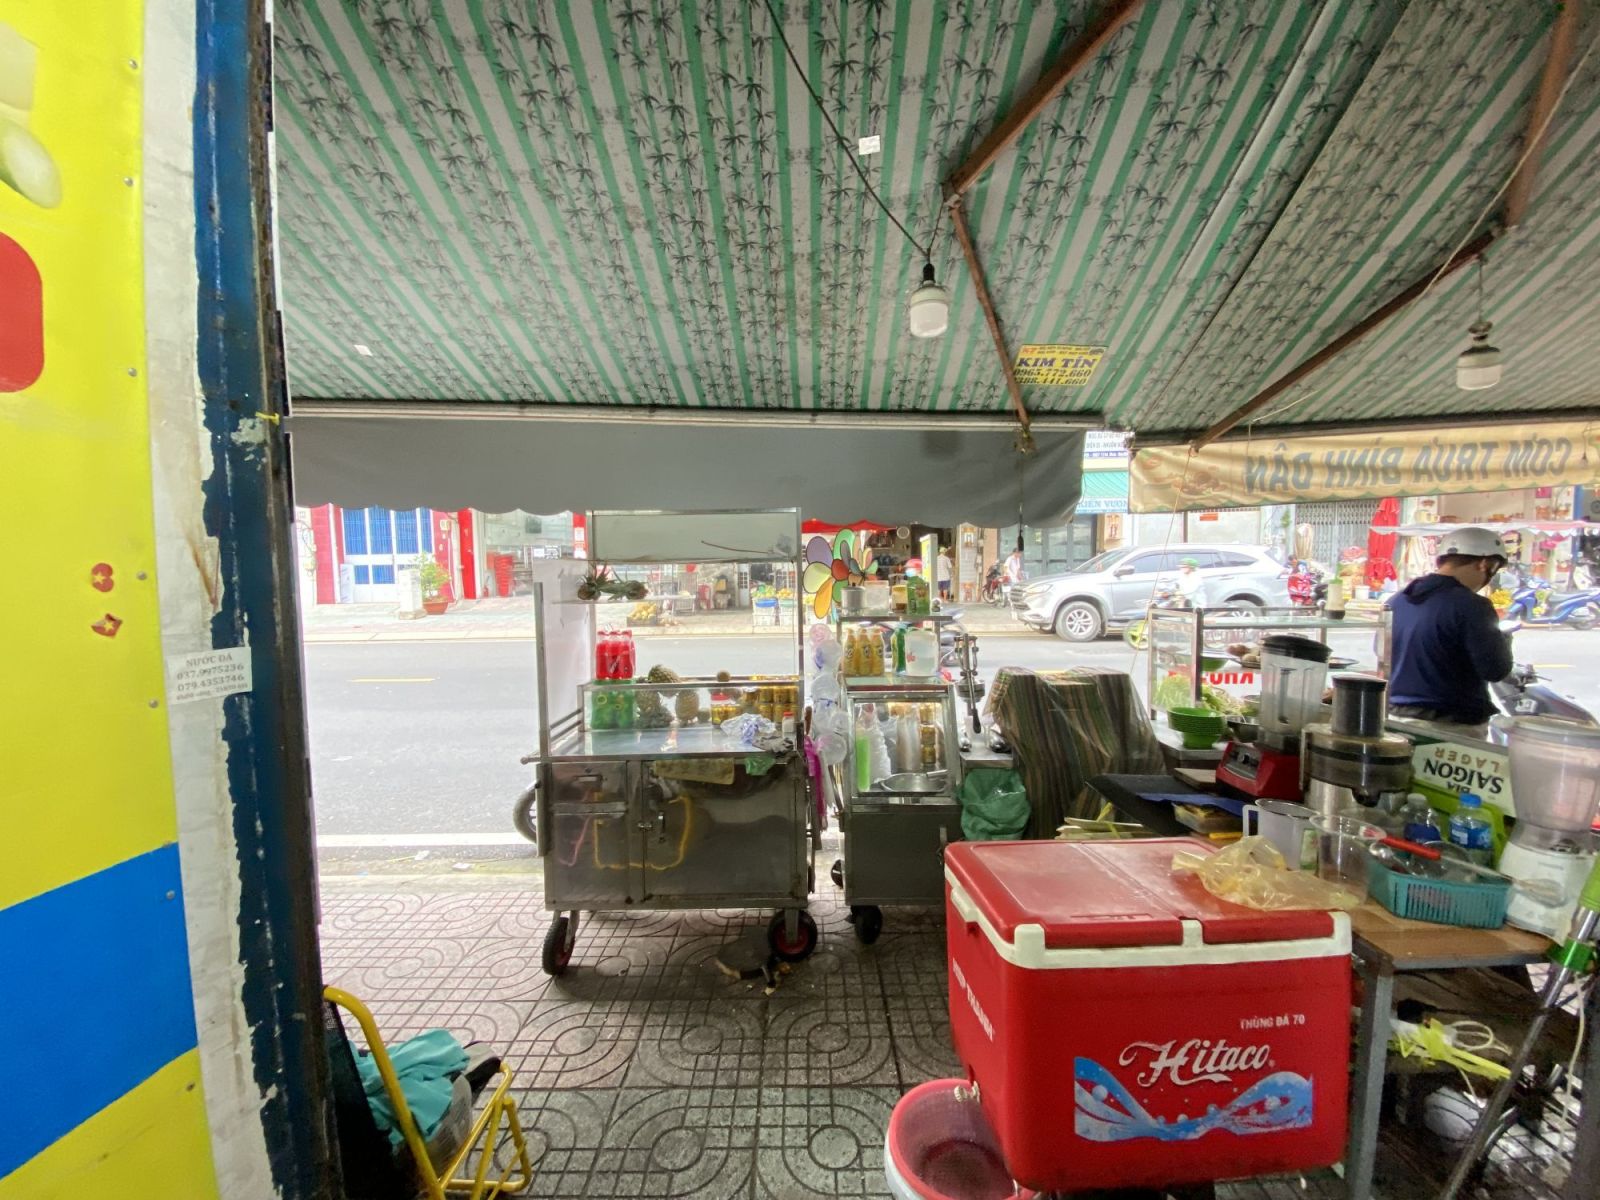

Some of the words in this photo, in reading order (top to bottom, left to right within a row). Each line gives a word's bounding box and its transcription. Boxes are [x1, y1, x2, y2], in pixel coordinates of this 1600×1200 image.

[1017, 357, 1056, 367] KIM
[1061, 354, 1099, 368] TÍN
[1434, 747, 1501, 773] LAGER
[1423, 757, 1504, 794] SAIGON
[1293, 1014, 1305, 1025] 70
[1119, 1039, 1270, 1087] Hitaco
